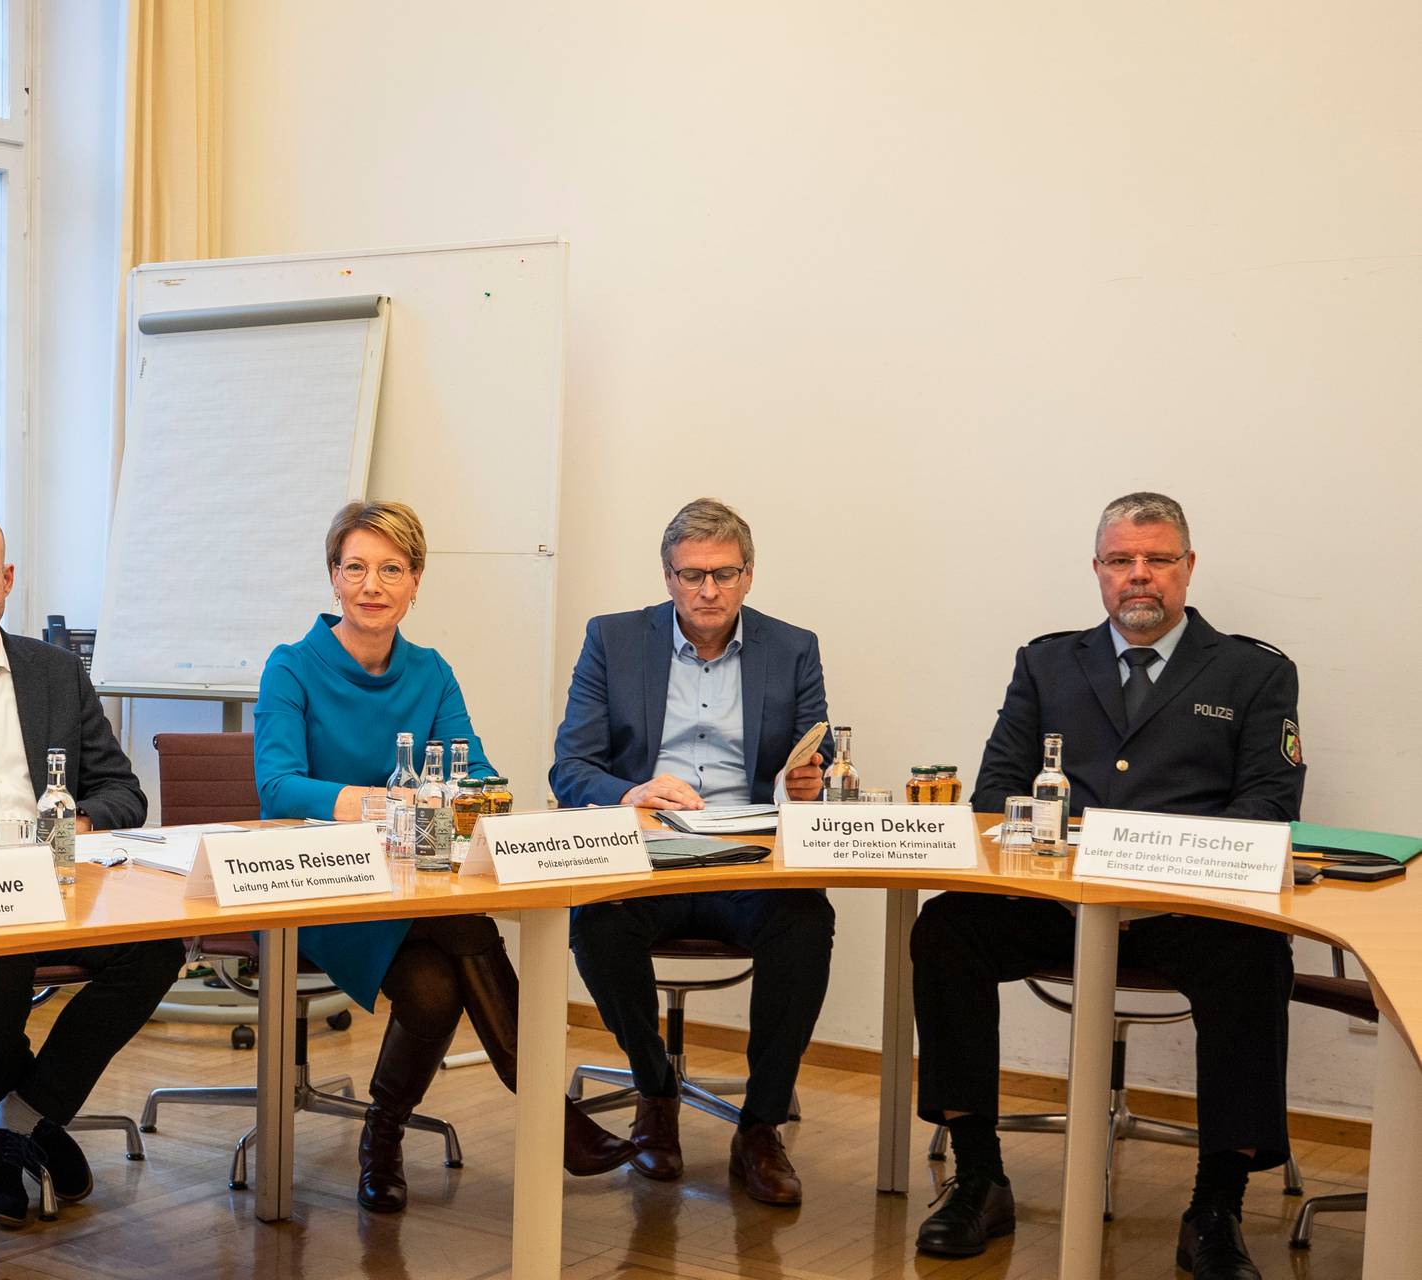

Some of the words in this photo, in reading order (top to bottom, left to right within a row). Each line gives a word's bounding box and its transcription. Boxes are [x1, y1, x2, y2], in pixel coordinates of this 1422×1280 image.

[811, 817, 874, 835] Jürgen
[882, 818, 945, 833] Dekker
[495, 837, 571, 855] Alexandra
[573, 831, 639, 849] Dorndorf
[802, 839, 829, 848] Leiter
[833, 839, 850, 848] der
[852, 839, 897, 848] Direktion
[899, 840, 956, 849] Kriminalität
[1113, 827, 1172, 845] Martin
[1179, 832, 1254, 852] Fischer
[224, 857, 295, 875] Thomas
[298, 851, 370, 869] Reisener
[537, 855, 610, 869] Polizeipräsidentin
[833, 851, 849, 859] der
[852, 851, 885, 859] Polizei
[887, 851, 928, 859] Münster
[1084, 847, 1113, 857] Leiter
[1115, 849, 1133, 859] der
[1135, 851, 1182, 863] Direktion
[1106, 860, 1144, 872] Einsatz
[1147, 863, 1164, 873] der
[1166, 865, 1202, 877] Polizei
[1204, 868, 1249, 881] Münster
[233, 882, 269, 893] Leitung
[271, 880, 289, 890] Amt
[291, 878, 304, 888] für
[306, 873, 375, 886] Kommunikation
